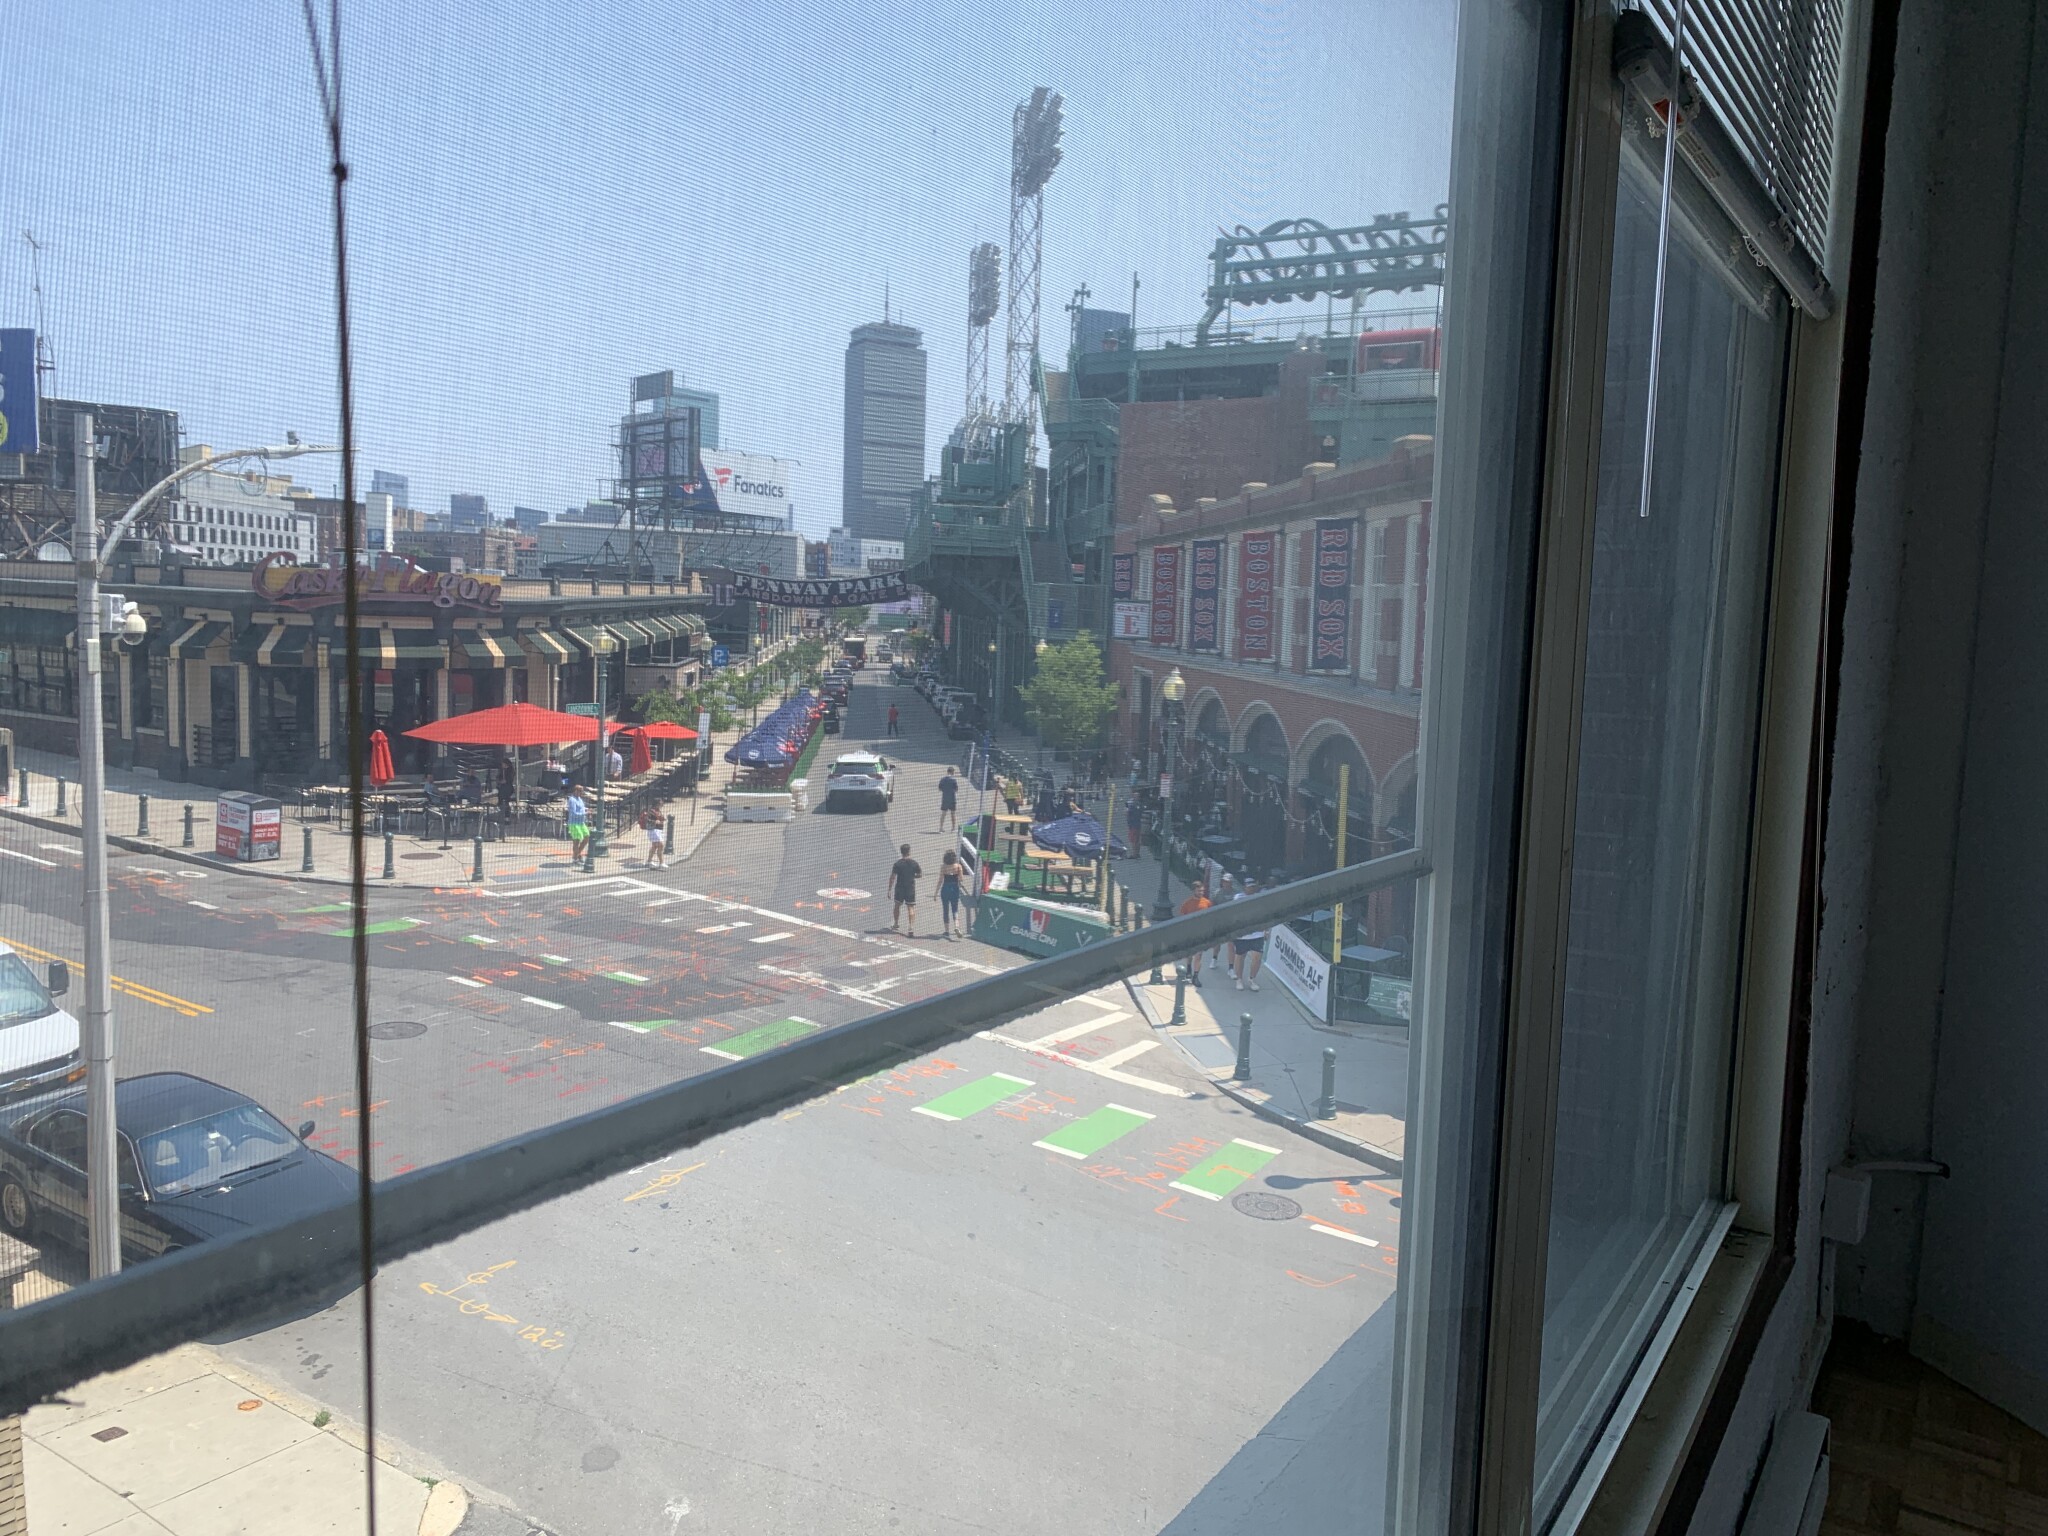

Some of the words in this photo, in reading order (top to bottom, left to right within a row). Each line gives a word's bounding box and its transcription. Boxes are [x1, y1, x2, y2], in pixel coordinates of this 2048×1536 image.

[734, 475, 784, 498] Fanatics
[1114, 558, 1131, 592] RED
[1195, 547, 1216, 590] RED
[1320, 528, 1348, 588] RED
[733, 586, 825, 605] LANSDOWNE
[849, 588, 888, 602] GATE
[735, 573, 832, 596] FENWAY
[838, 571, 904, 595] PARK
[1154, 553, 1175, 637] BOSTON
[1245, 539, 1271, 652] BOSTON
[1123, 614, 1140, 635] E
[1193, 597, 1215, 642] SOX
[1317, 599, 1345, 660] SOX
[1010, 925, 1039, 940] GAME
[1274, 935, 1306, 976] SUMMER
